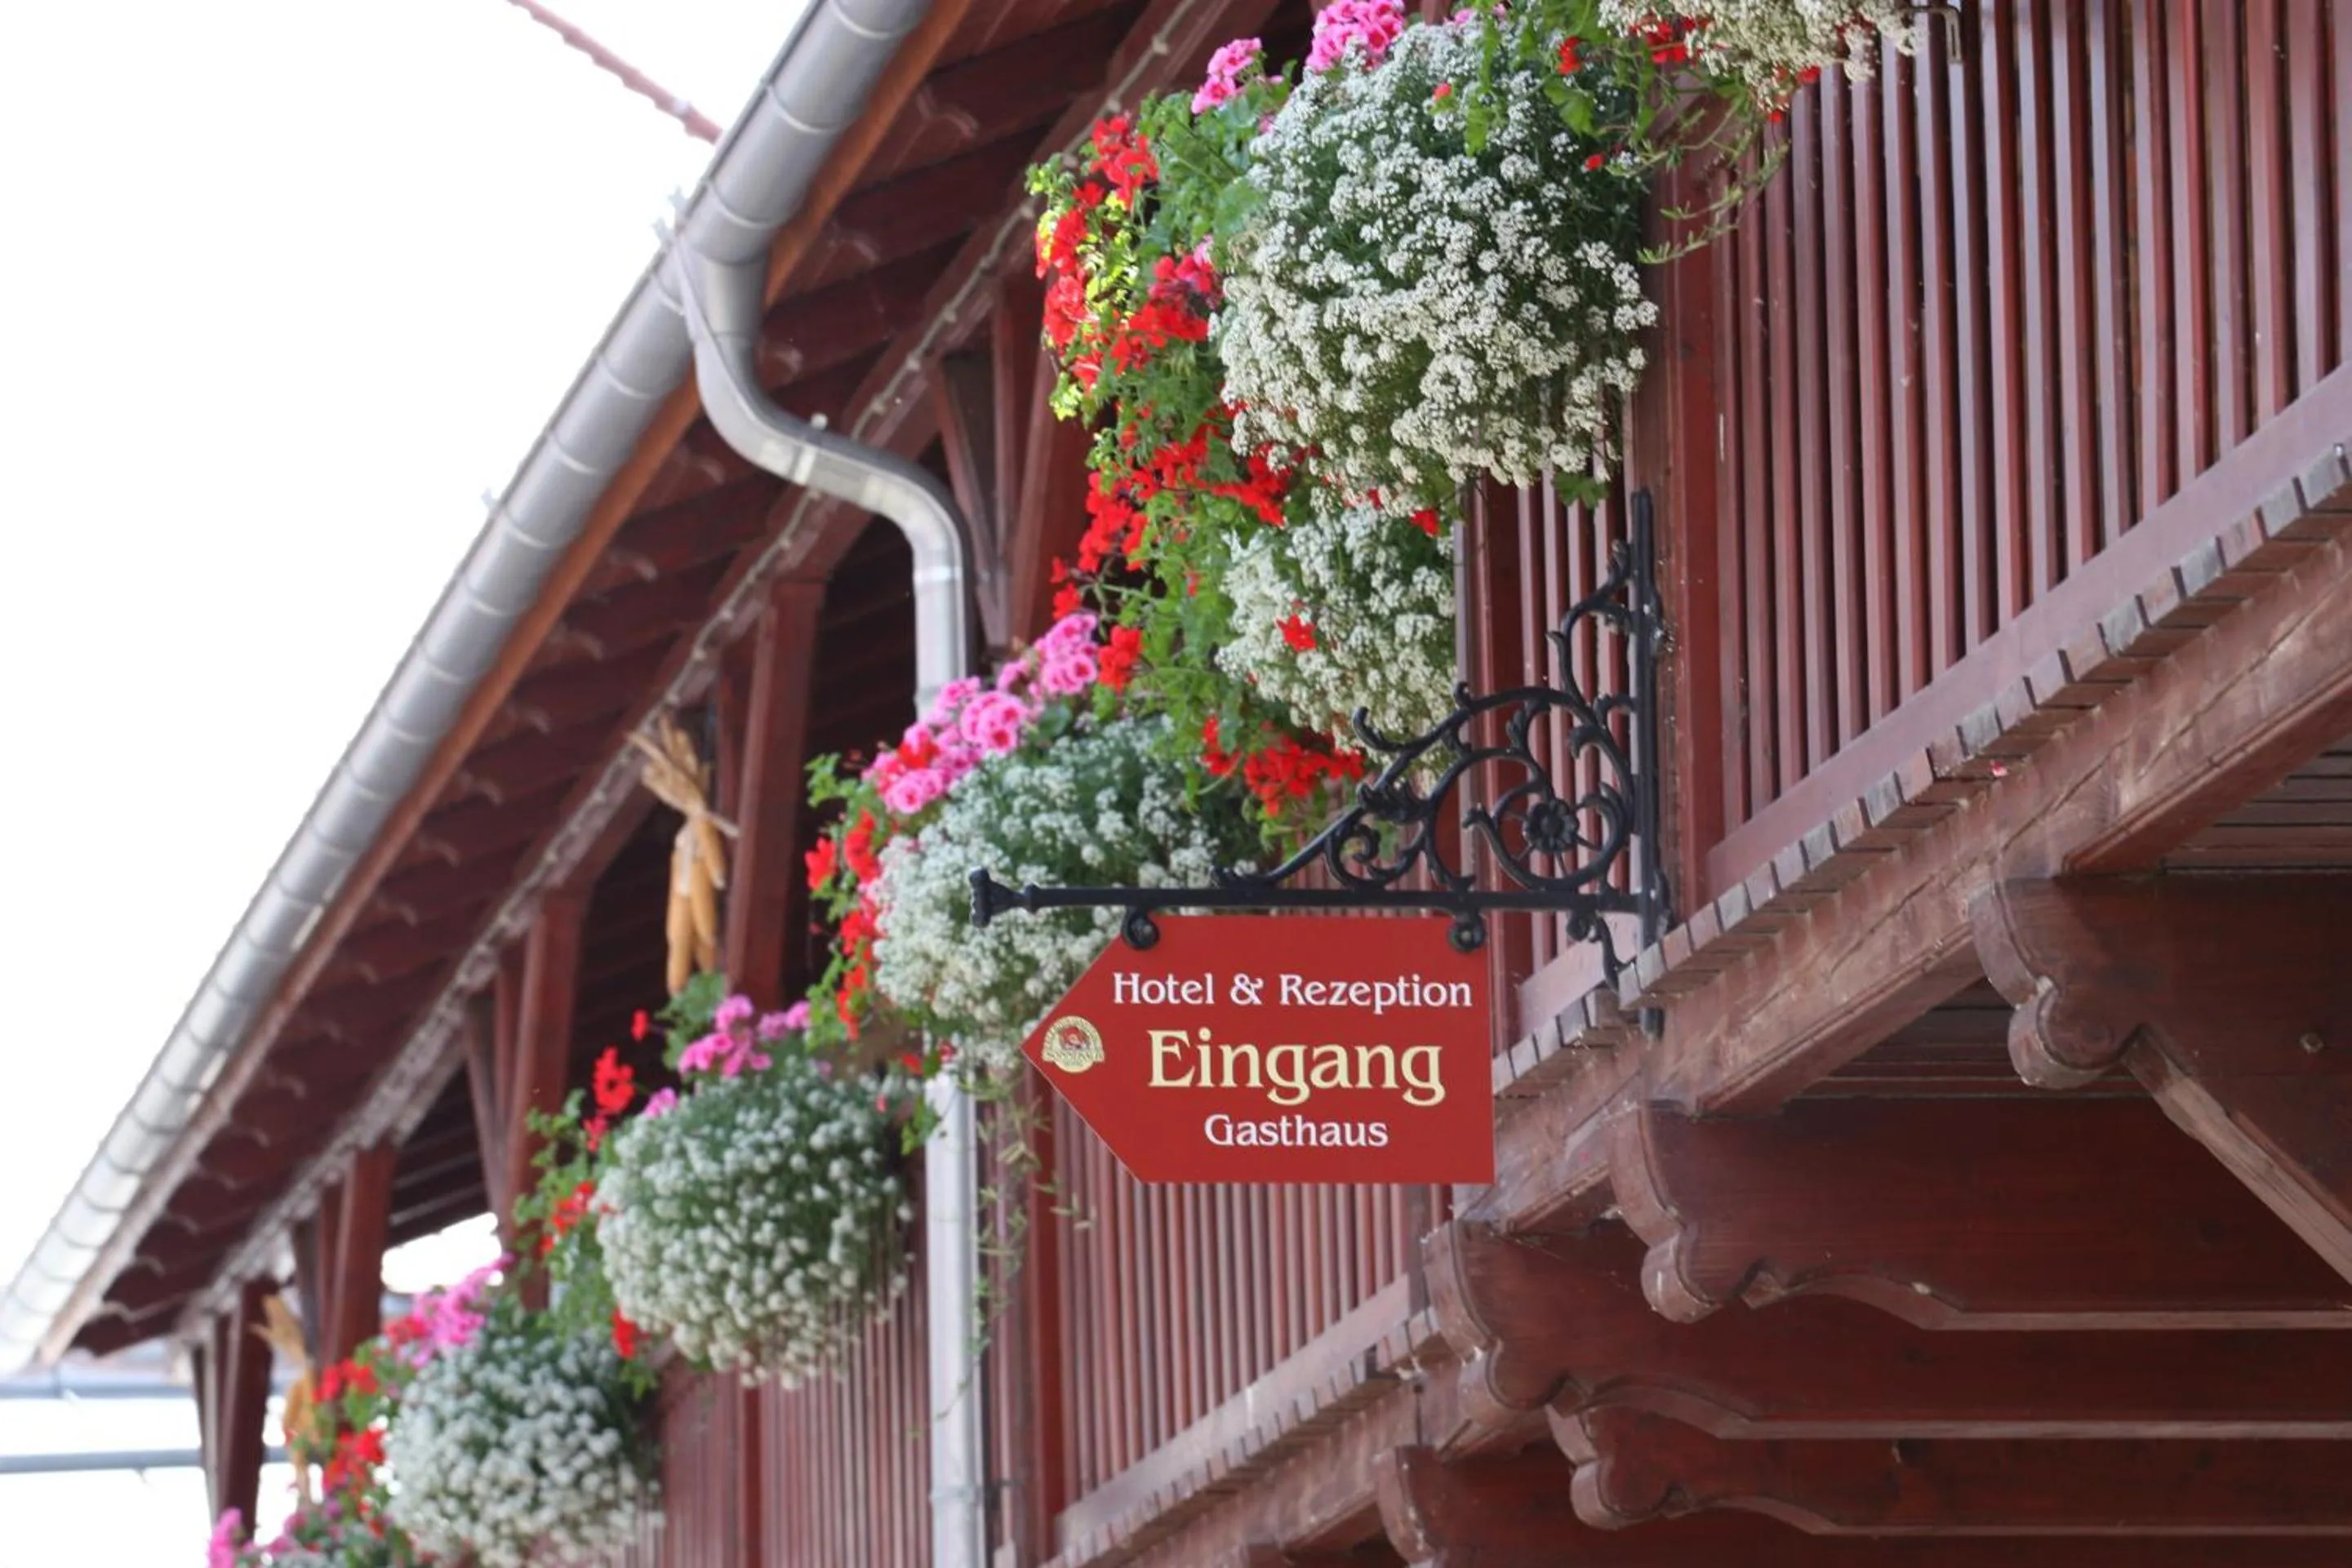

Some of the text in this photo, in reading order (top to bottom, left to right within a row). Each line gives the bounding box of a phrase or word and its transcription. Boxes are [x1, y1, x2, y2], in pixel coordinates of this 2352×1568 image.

[1113, 972, 1473, 1015] Hotel & Rezeption
[1147, 1026, 1446, 1107] Eingang
[1204, 1113, 1389, 1147] Gasthaus
